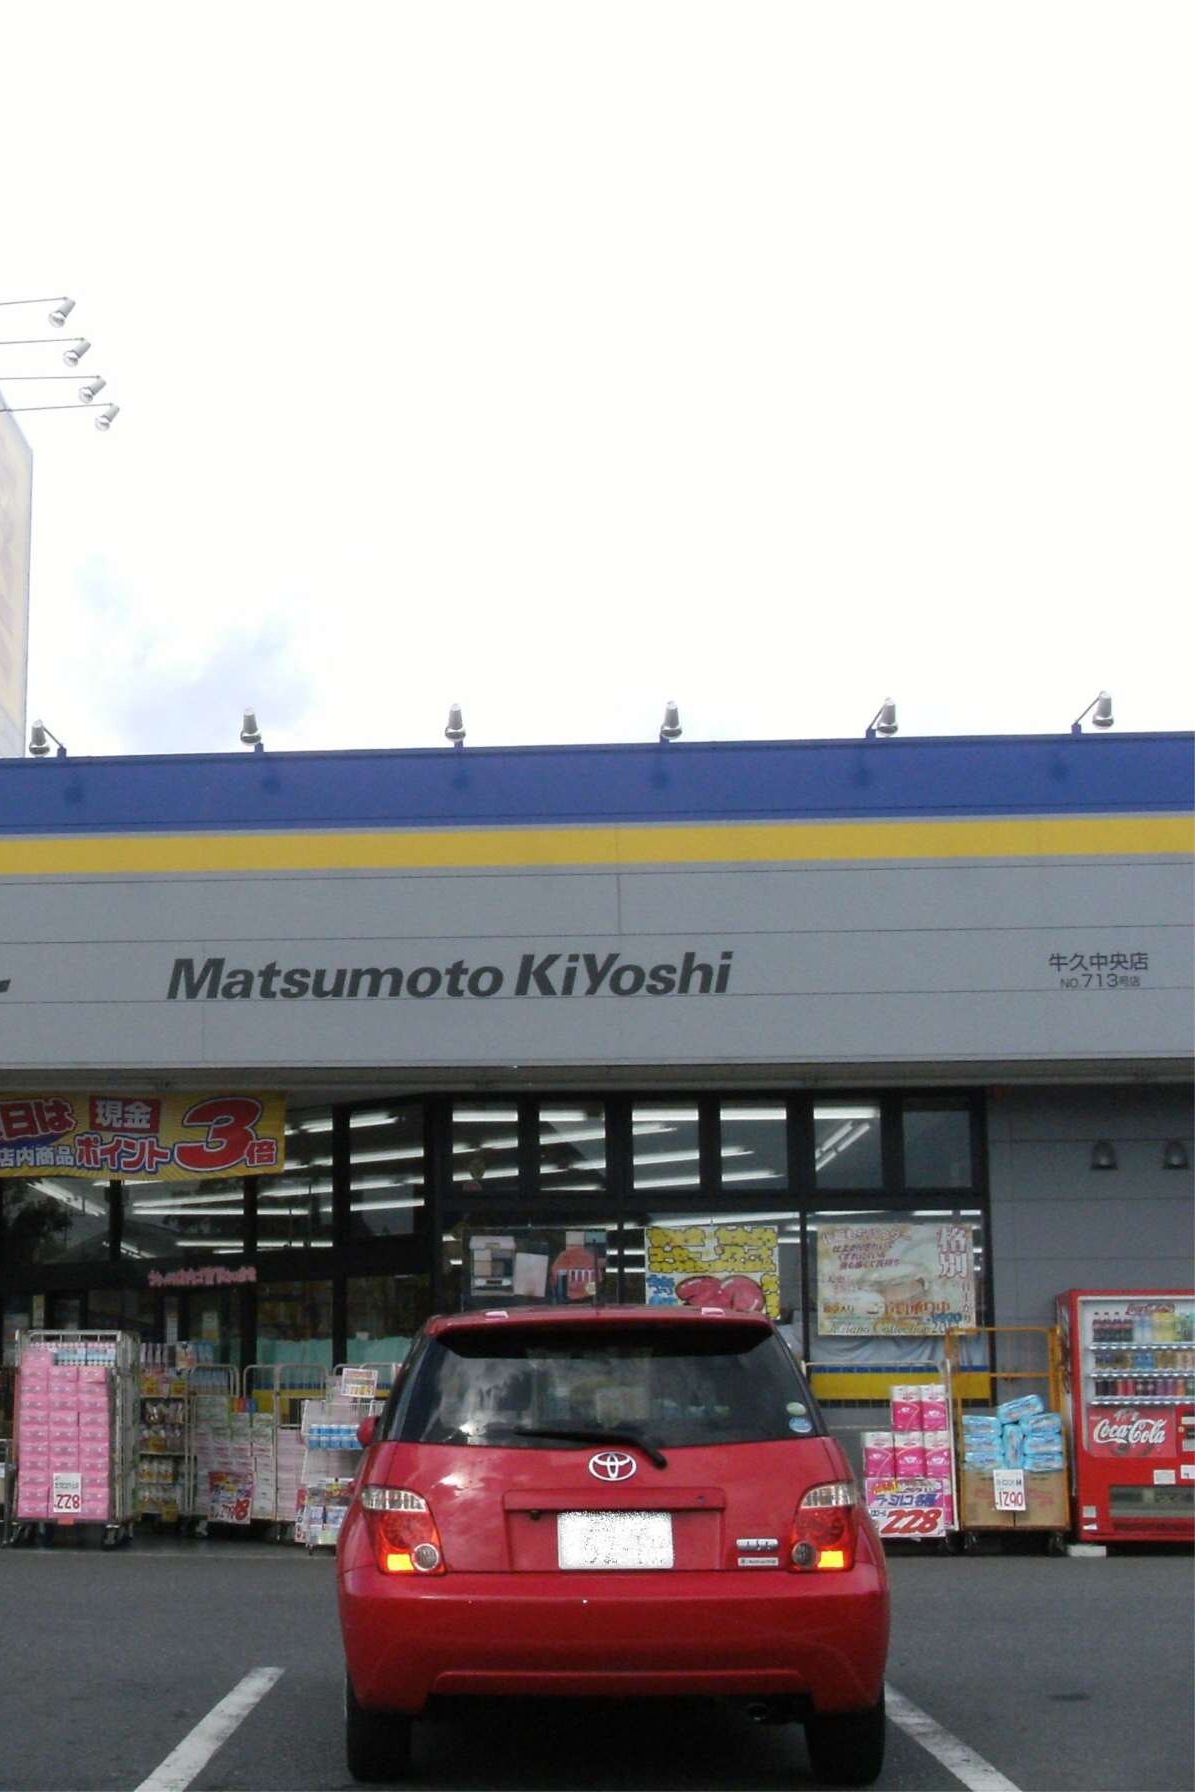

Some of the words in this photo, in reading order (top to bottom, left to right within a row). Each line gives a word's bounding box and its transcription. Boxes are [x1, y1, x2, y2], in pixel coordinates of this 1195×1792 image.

[166, 957, 505, 1000] Matsumoto
[514, 951, 734, 997] KiYoshi
[1048, 952, 1149, 972] 牛久中央店
[95, 1100, 153, 1129] 現金
[880, 1508, 943, 1534] 228
